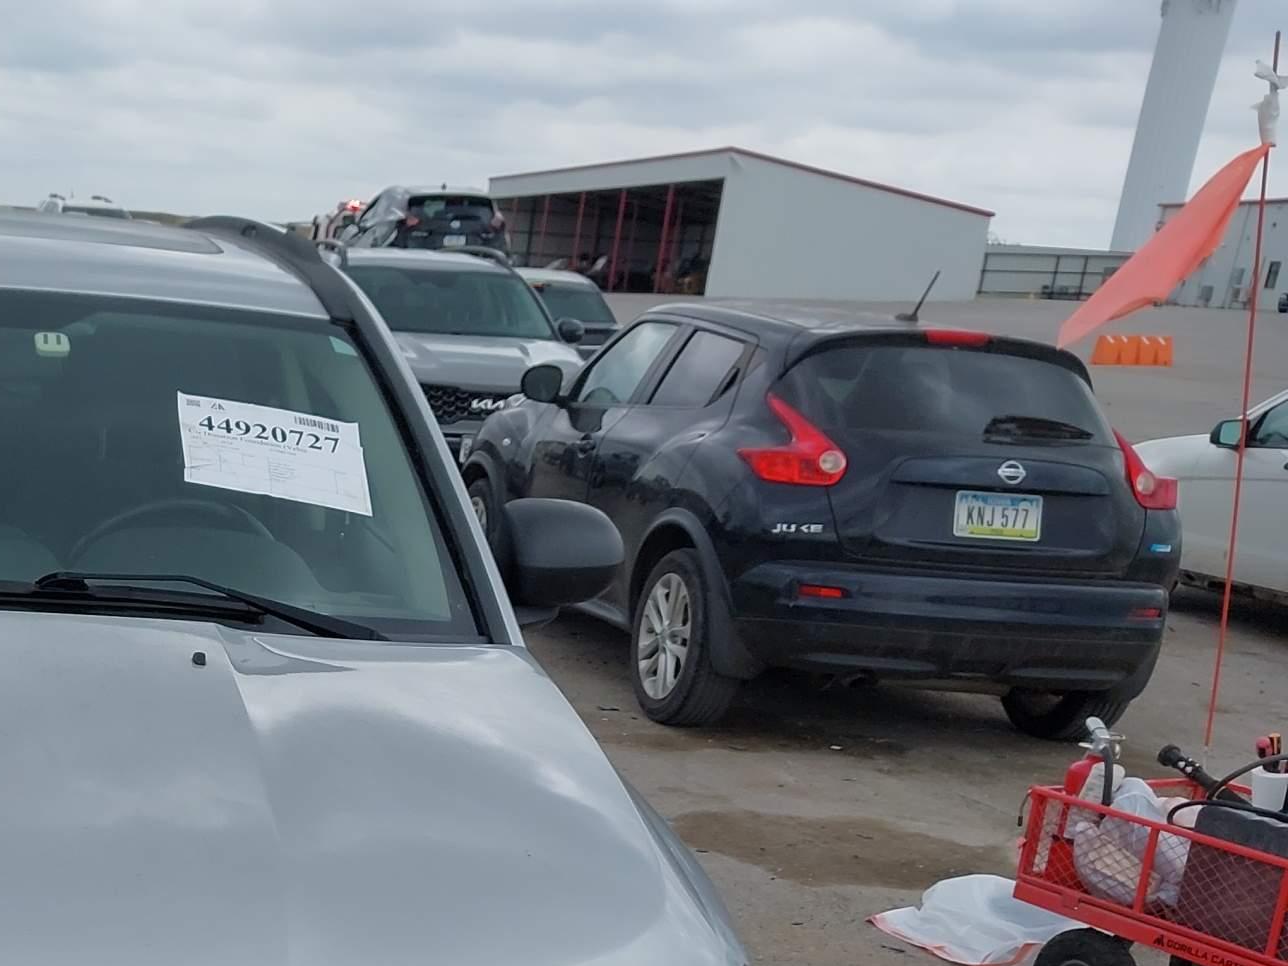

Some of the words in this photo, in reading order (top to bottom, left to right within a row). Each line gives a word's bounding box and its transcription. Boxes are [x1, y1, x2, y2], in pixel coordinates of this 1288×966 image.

[198, 415, 340, 453] 44920727
[966, 506, 995, 527] KNJ
[1000, 508, 1030, 529] 577
[771, 523, 824, 534] JUKE
[1166, 940, 1208, 960] GORILLA
